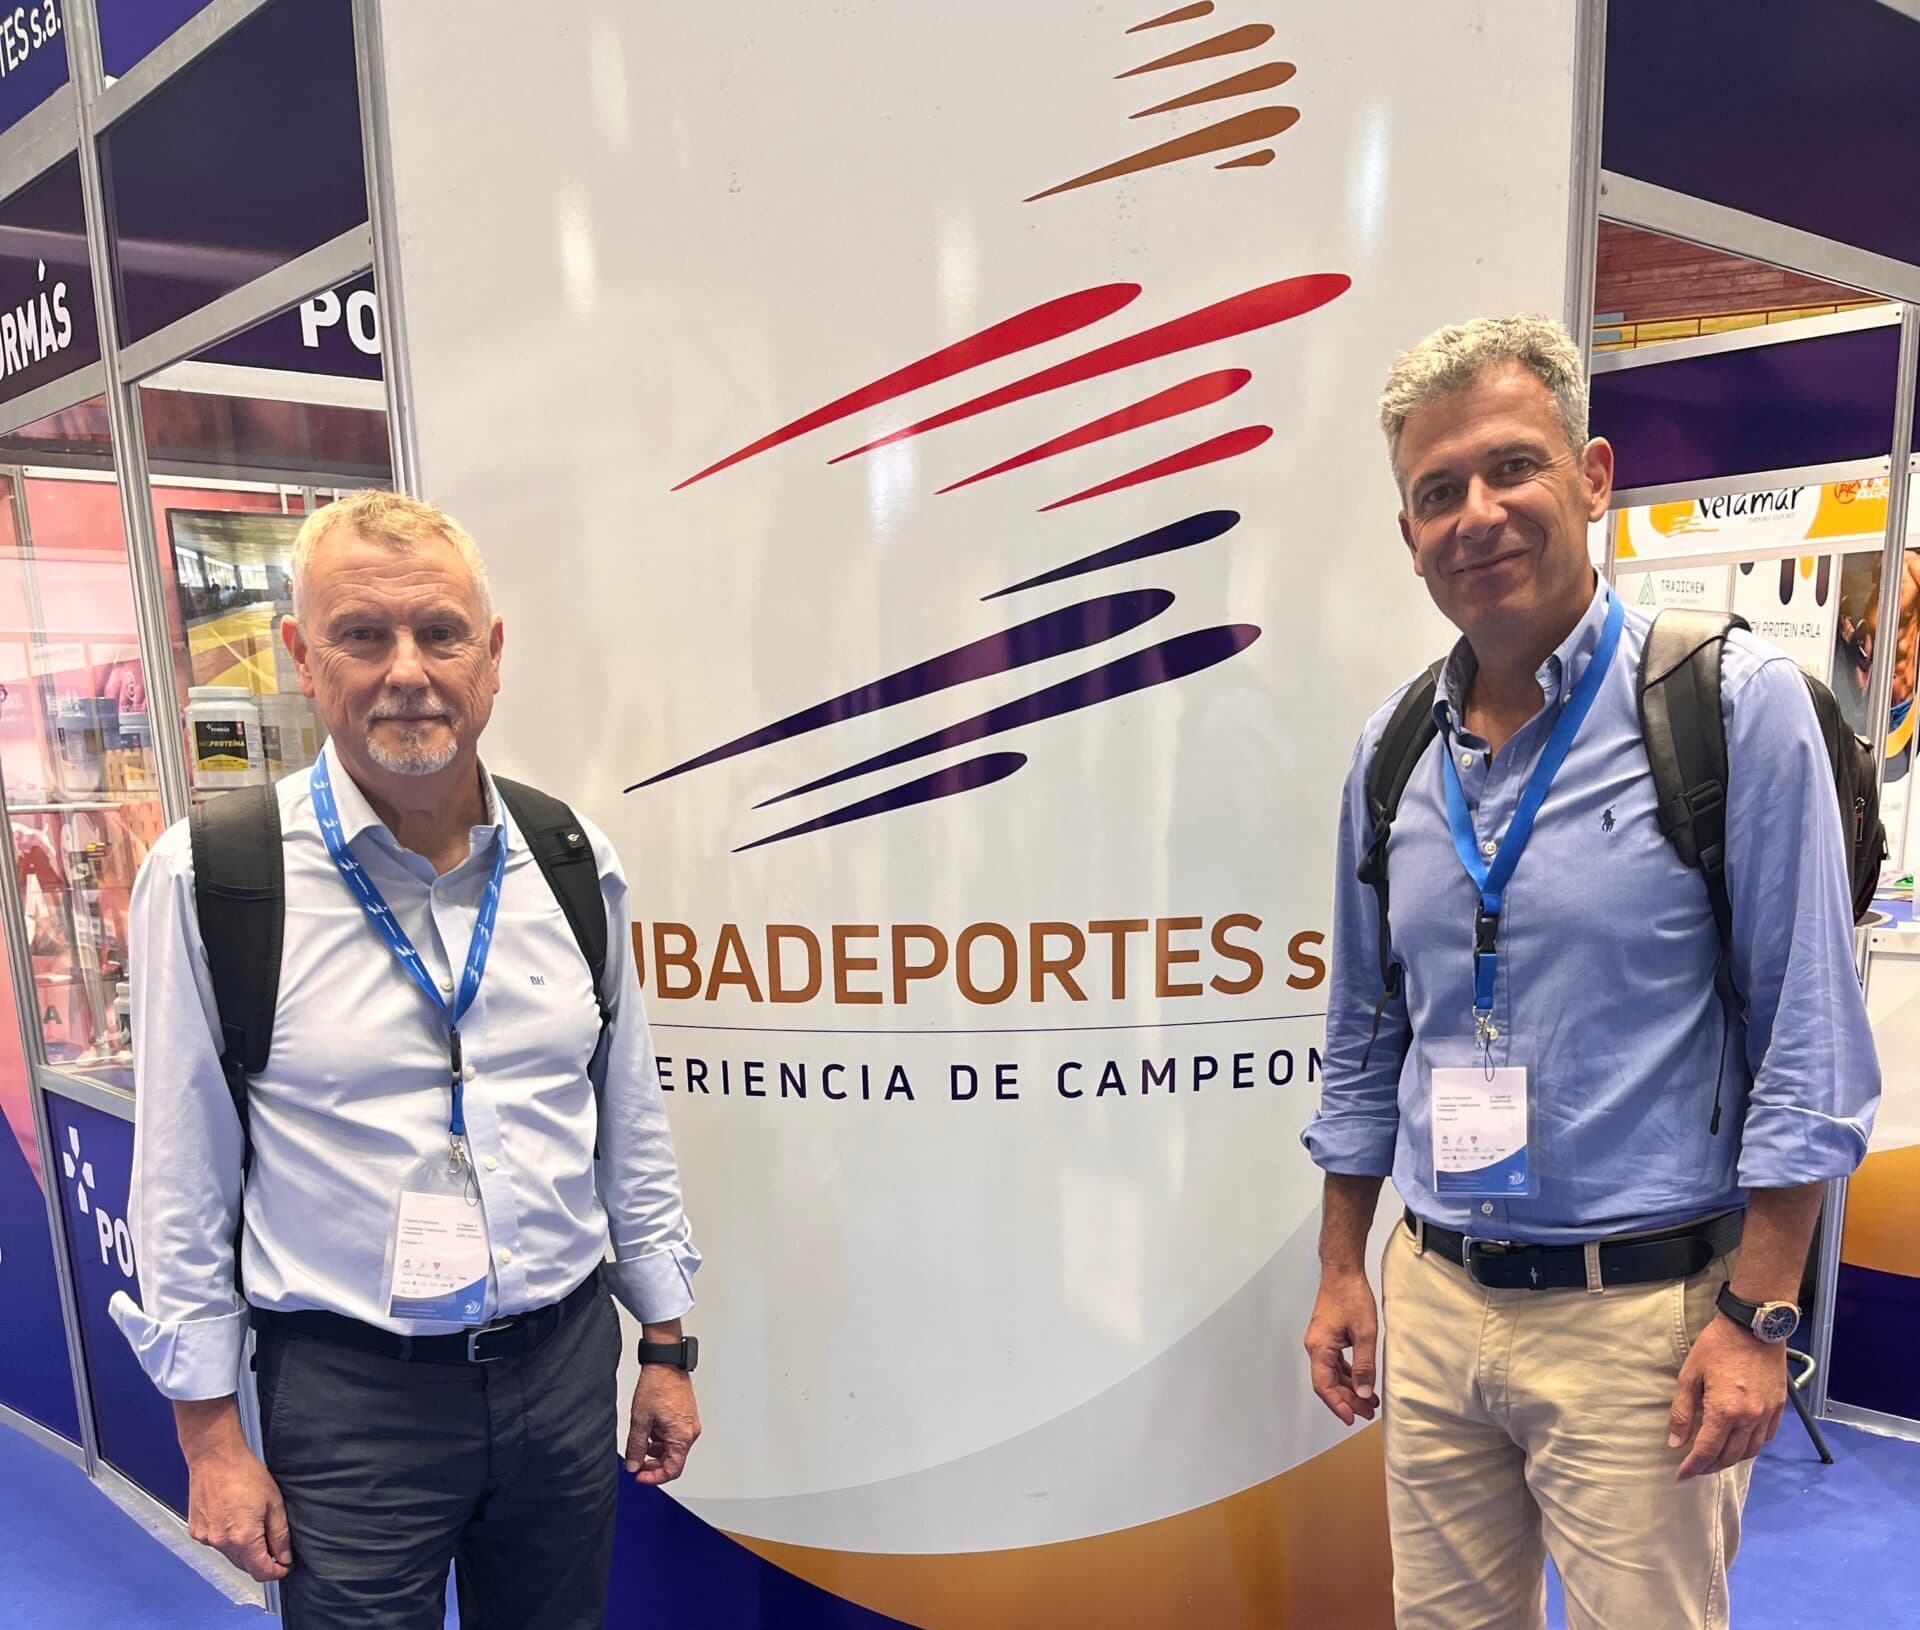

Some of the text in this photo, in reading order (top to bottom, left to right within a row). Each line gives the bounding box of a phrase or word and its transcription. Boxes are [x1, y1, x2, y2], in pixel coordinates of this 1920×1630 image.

[0, 259, 72, 380] RMÁS
[1762, 621, 1798, 638] PROTEIN
[1799, 623, 1821, 638] ARLA
[951, 1064, 1019, 1101] DE
